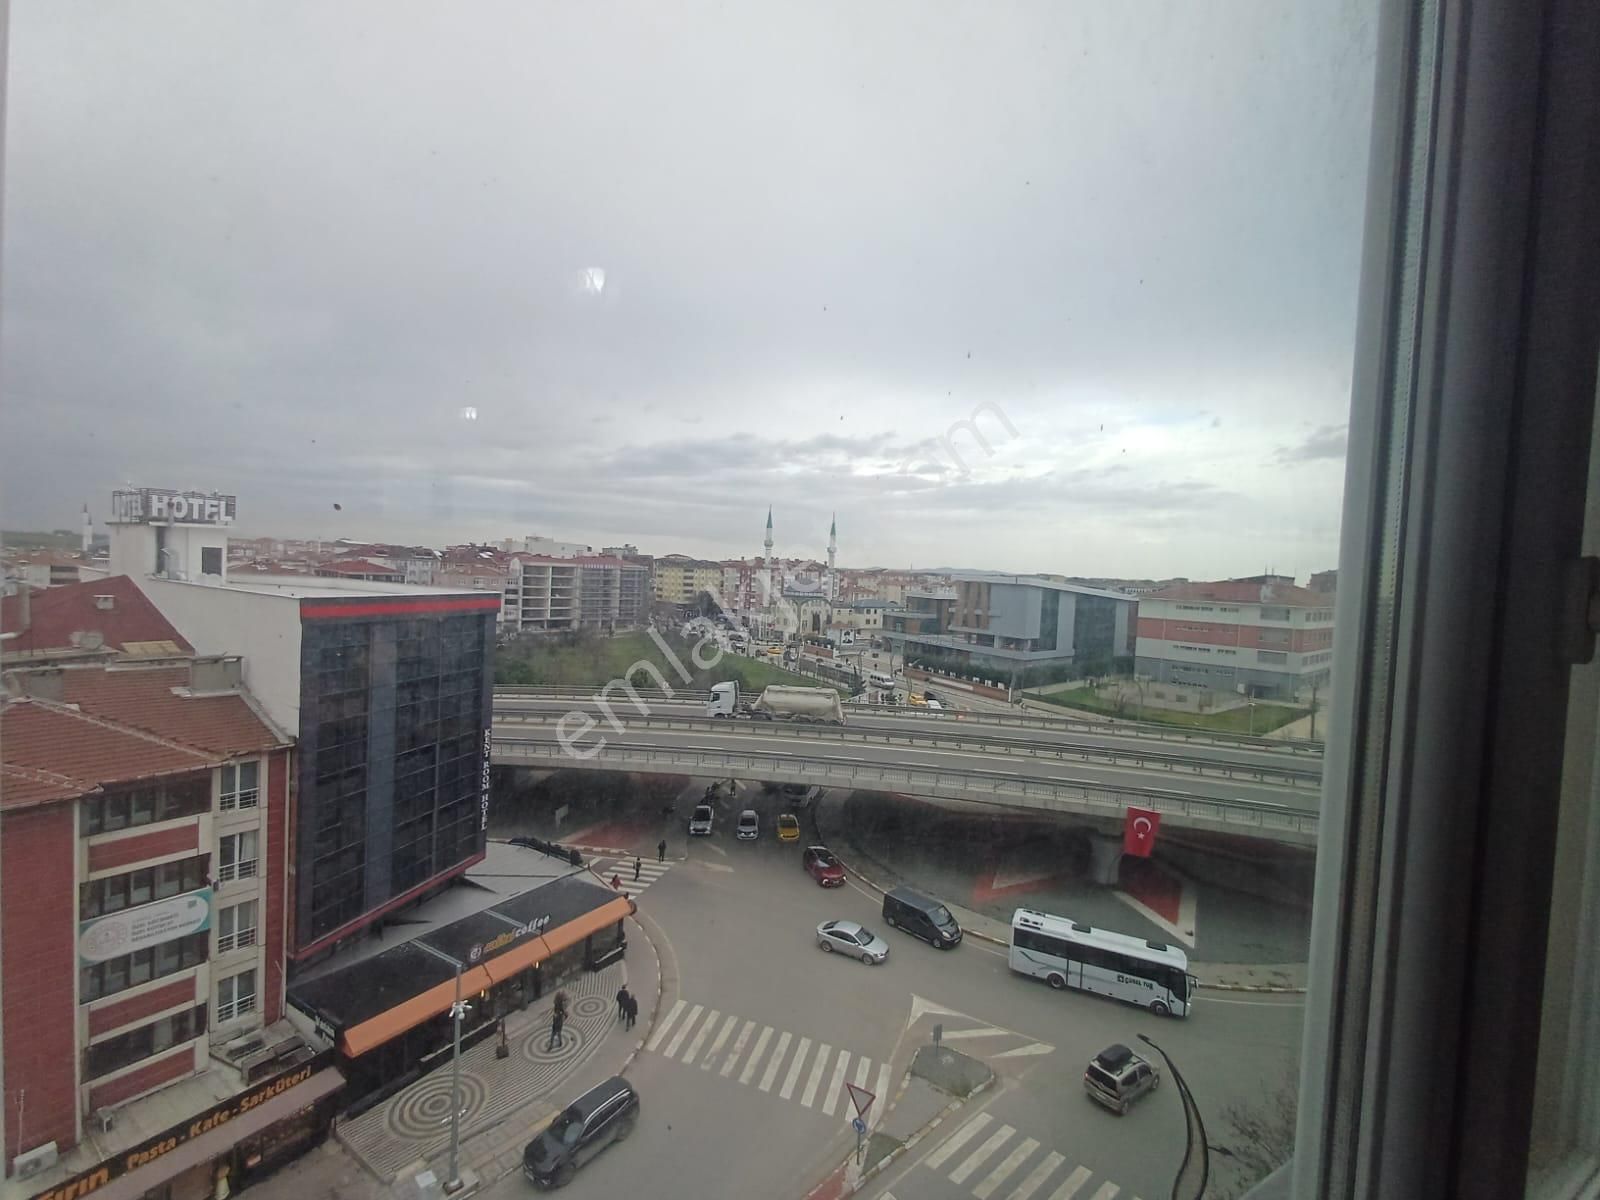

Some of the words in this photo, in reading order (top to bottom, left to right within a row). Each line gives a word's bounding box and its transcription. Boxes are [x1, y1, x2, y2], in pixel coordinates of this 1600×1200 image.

[151, 494, 232, 521] HOTEL
[482, 761, 490, 791] ROOM
[481, 794, 489, 831] HOTEL
[128, 1136, 177, 1170] Pasta
[190, 1110, 230, 1138] Kafe
